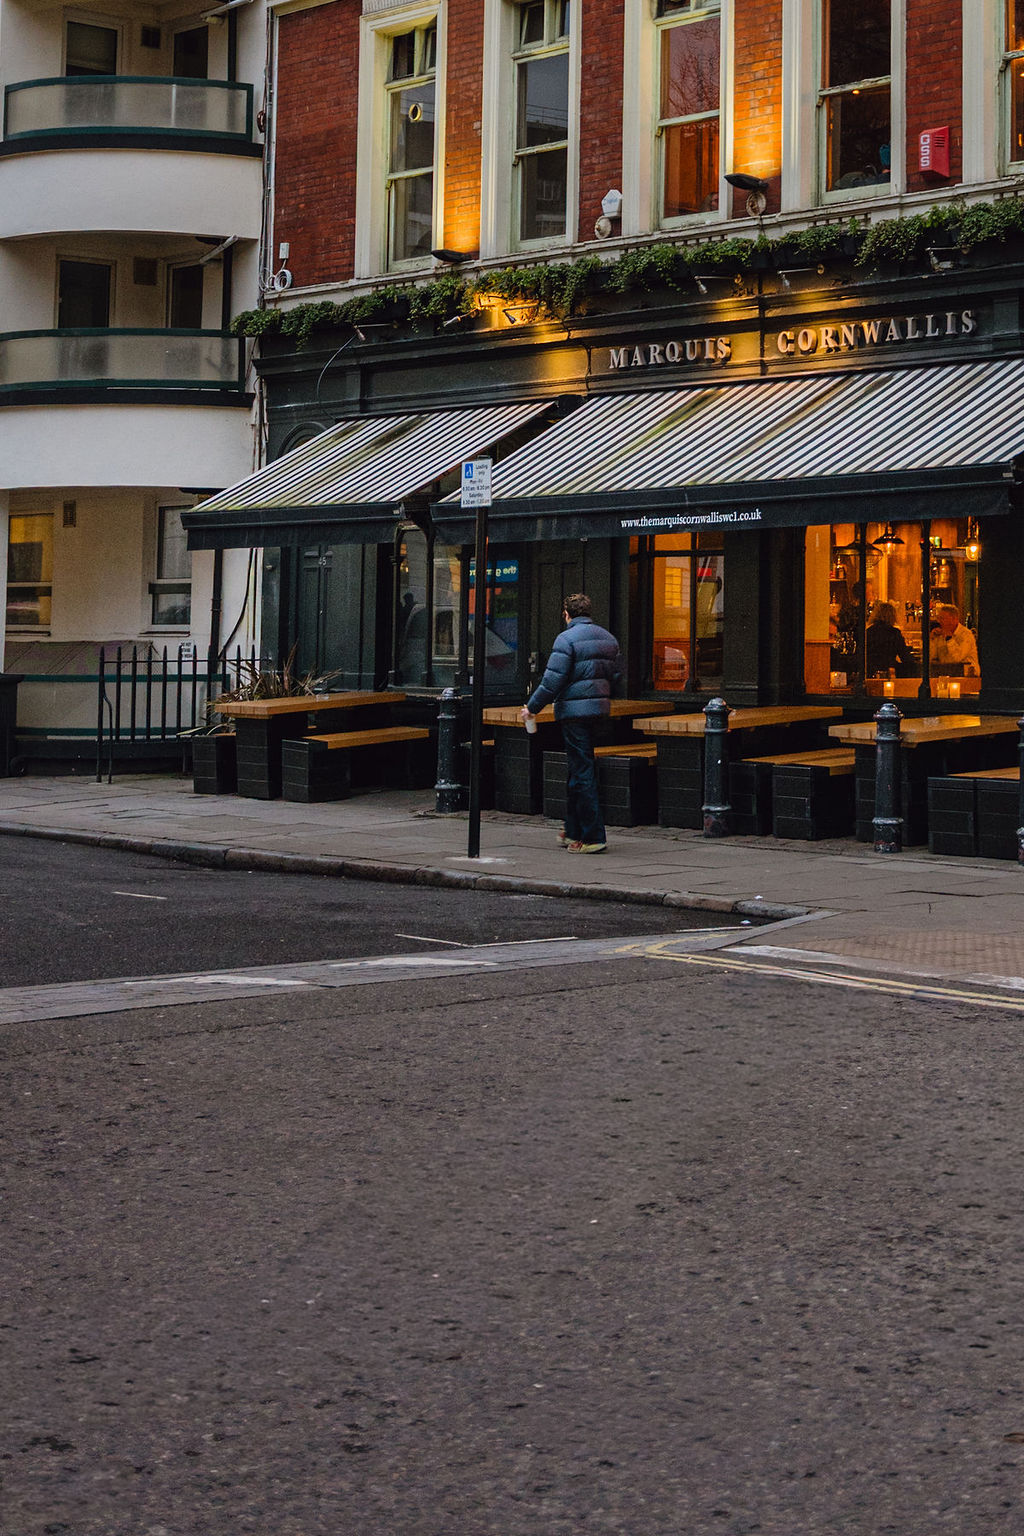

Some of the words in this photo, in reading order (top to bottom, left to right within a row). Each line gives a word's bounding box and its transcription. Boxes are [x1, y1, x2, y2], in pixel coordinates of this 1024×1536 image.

[609, 337, 731, 369] MARQUIS
[777, 310, 977, 355] CORNWALLIS
[621, 508, 762, 528] www.themarquiscornwalliswc1.co.uk
